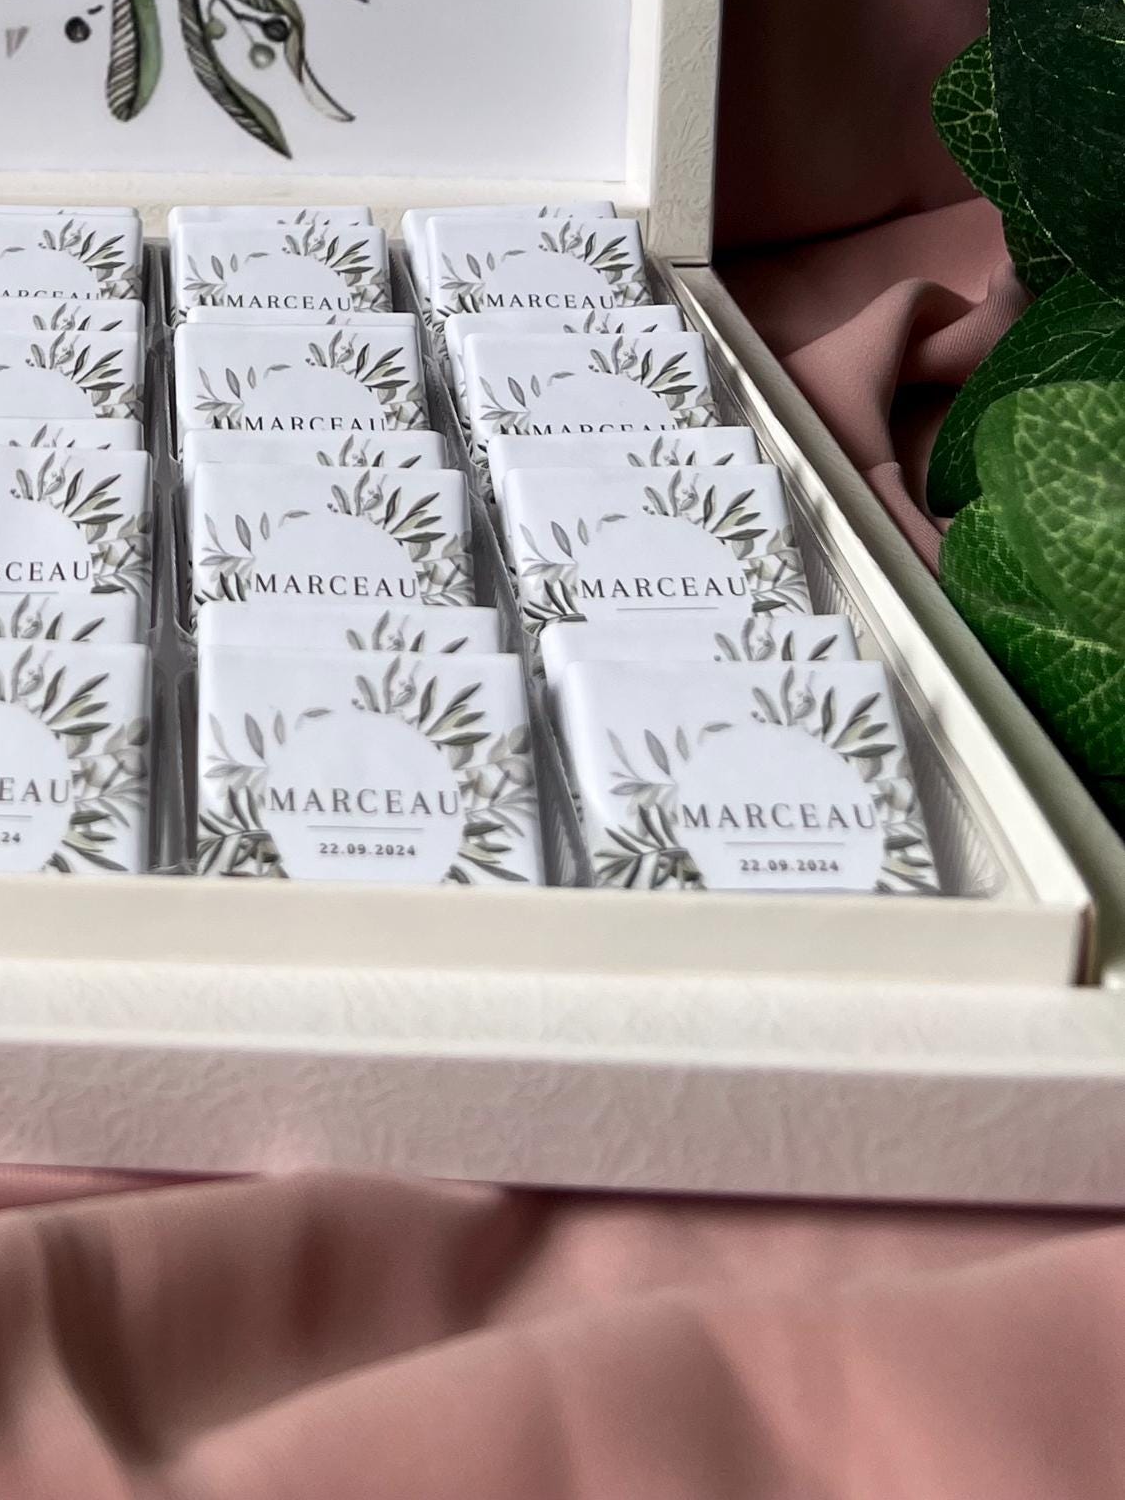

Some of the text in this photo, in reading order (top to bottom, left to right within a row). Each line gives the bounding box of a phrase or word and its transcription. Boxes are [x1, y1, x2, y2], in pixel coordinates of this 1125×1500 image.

[227, 293, 351, 312] MARCEAU
[487, 293, 615, 310] MARCEAU
[254, 573, 417, 598] MARCEAU
[580, 576, 747, 599] MARCEAU
[269, 786, 460, 816] MARCEAU
[681, 802, 876, 830] MARCEAU
[319, 842, 417, 857] 22.09.2024
[739, 858, 840, 873] 22.09.2024
